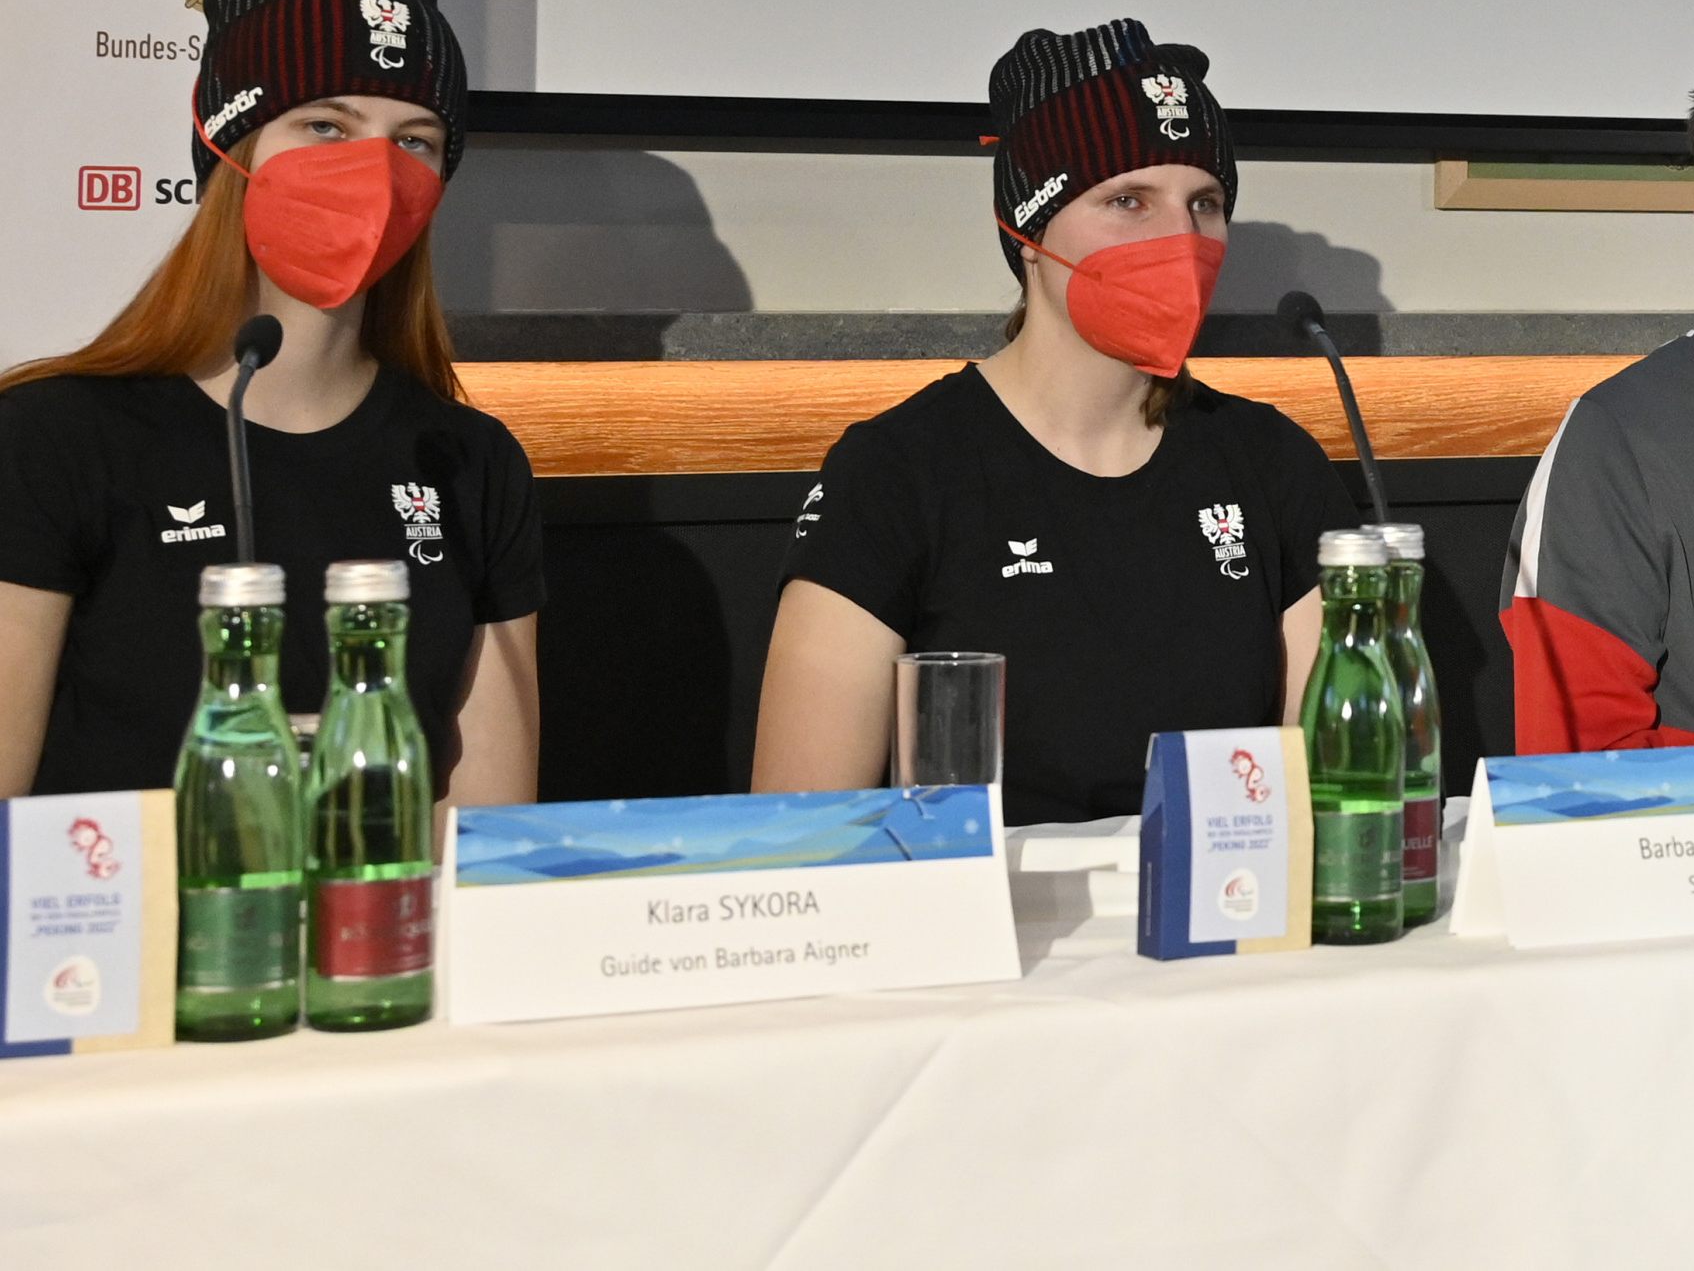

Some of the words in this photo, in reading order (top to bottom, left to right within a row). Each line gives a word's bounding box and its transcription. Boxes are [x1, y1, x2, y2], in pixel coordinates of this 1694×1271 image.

[86, 173, 134, 204] DB
[160, 523, 227, 544] erima
[405, 526, 443, 538] AUSTRIA
[1214, 544, 1247, 559] AUSTRIA
[1001, 558, 1054, 579] erima
[646, 899, 711, 925] Klara
[718, 890, 821, 921] SYKORA
[600, 954, 663, 978] Guide
[669, 954, 708, 973] von
[715, 946, 797, 970] Barbara
[803, 940, 871, 966] Aigner
